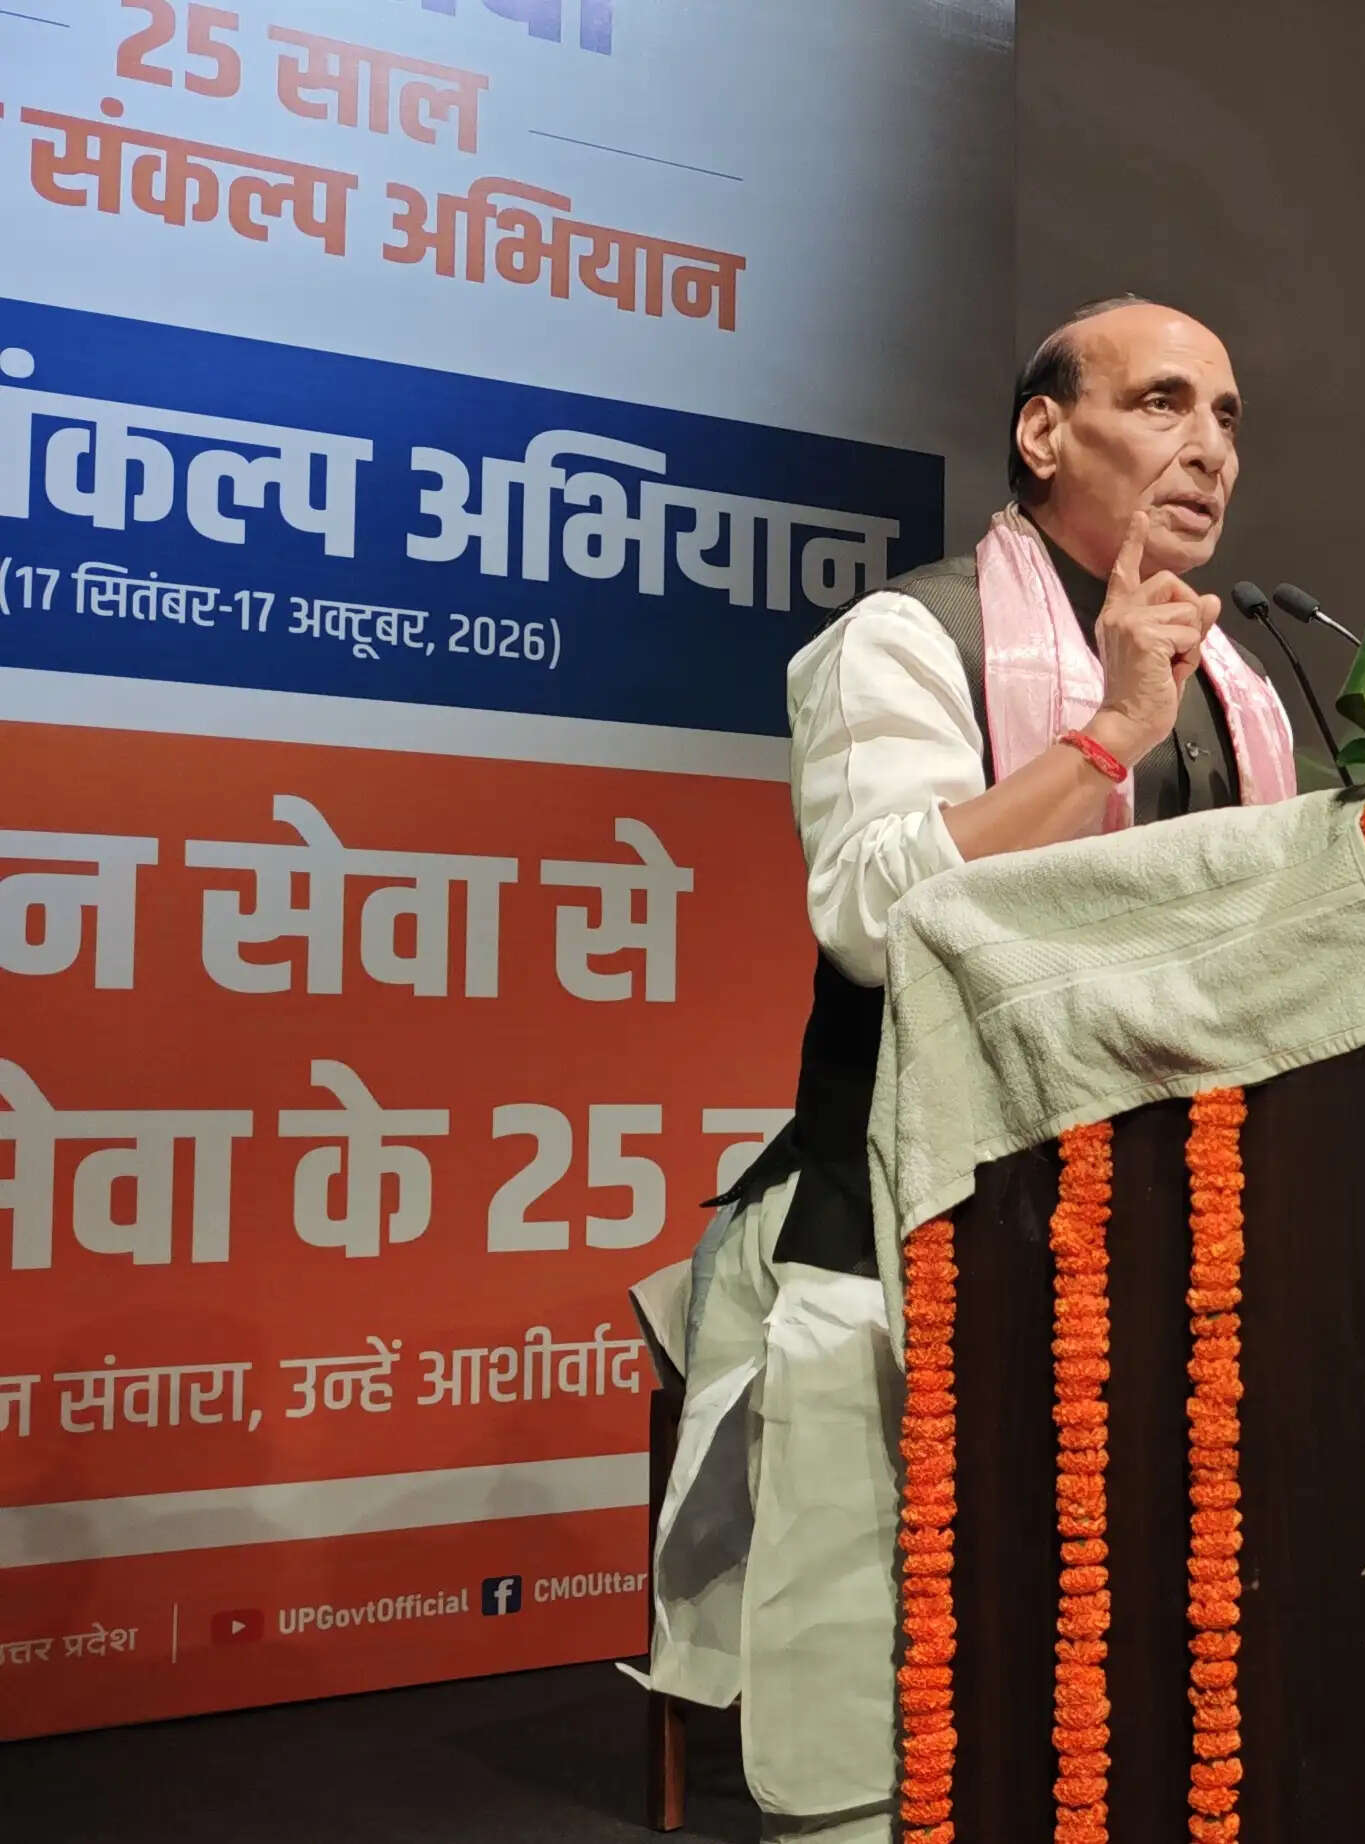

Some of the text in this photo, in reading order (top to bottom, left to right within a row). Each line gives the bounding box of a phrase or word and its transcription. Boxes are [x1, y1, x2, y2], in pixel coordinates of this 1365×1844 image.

[116, 0, 241, 98] 25
[267, 25, 488, 156] साल
[20, 97, 746, 333] संकल्प अभियान
[406, 428, 899, 612] अभियान
[448, 612, 561, 670] 2026)
[0, 795, 694, 1002] न सेवा से
[278, 1059, 450, 1258] के
[487, 1104, 666, 1253] 25
[53, 1354, 262, 1433] संवारा,
[280, 1336, 402, 1419] उन्हें
[418, 1323, 646, 1407] आशीर्वाद
[63, 1622, 139, 1657] प्रदेश
[278, 1588, 469, 1634] UPGovtOfficial
[534, 1572, 648, 1602] CMOUttar
